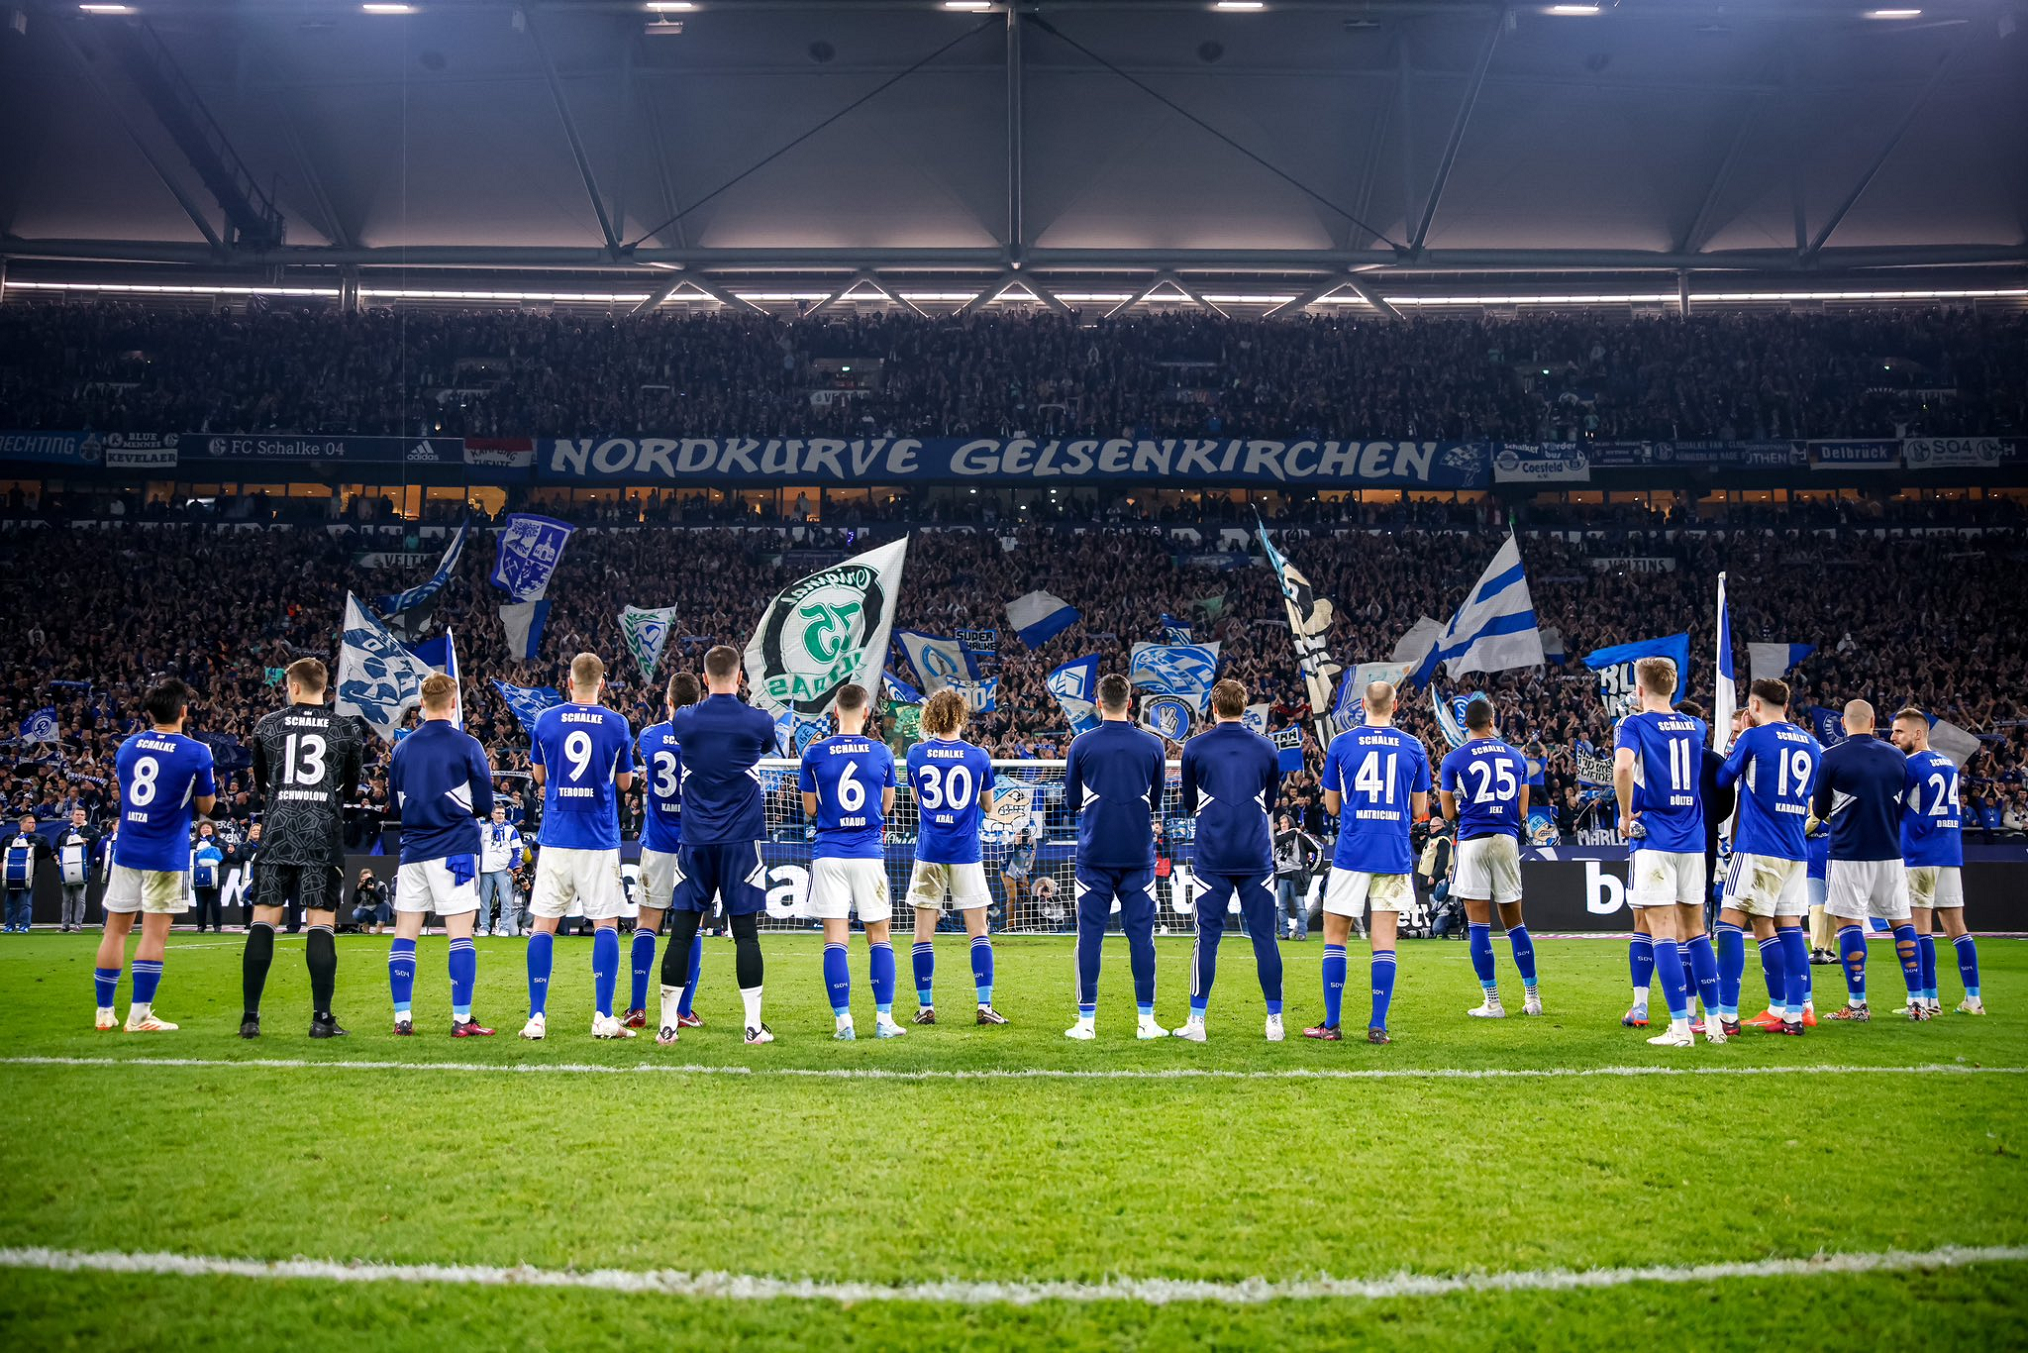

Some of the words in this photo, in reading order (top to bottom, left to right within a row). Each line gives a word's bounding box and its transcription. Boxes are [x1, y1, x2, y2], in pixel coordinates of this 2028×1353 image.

[128, 432, 157, 441] BLUE
[0, 436, 76, 455] ECHTING
[231, 440, 252, 454] FC
[257, 440, 320, 455] Schalke
[325, 442, 344, 456] 04
[1504, 443, 1539, 454] Schalker
[1822, 445, 1888, 459] Delbrück
[108, 452, 176, 463] KEVELAER
[407, 452, 439, 461] adidas
[551, 438, 923, 479] NORDKURVE
[949, 438, 1437, 482] GELSENKIRCHEN
[1522, 462, 1563, 473] Coesfeld
[1608, 559, 1666, 573] VLTINS
[284, 716, 330, 728] SCHALKE
[561, 712, 603, 724] SCHALKE
[1658, 720, 1696, 732] SCHALKE
[1358, 736, 1400, 747] SCHALKE
[1776, 731, 1810, 744] SCHALKE
[136, 738, 176, 753] SCHALKE
[829, 744, 870, 755] SCHALKE
[1471, 745, 1506, 756] SCHALKE
[284, 733, 327, 786] 13
[564, 730, 592, 782] 9
[926, 749, 964, 758] SCHALKE
[1668, 737, 1692, 791] 11
[653, 750, 682, 798] 3
[1354, 751, 1398, 804] 41
[1777, 748, 1813, 798] 19
[130, 756, 160, 807] 8
[837, 760, 866, 812] 6
[919, 764, 973, 810] 30
[1468, 758, 1517, 804] 25
[278, 790, 328, 802] SCHWOLOW
[558, 787, 594, 798] TERODDE
[1928, 772, 1961, 816] 24
[1670, 794, 1694, 806] BÜLTER
[127, 810, 148, 824] LATZA
[1356, 810, 1400, 821] MATRICIANI
